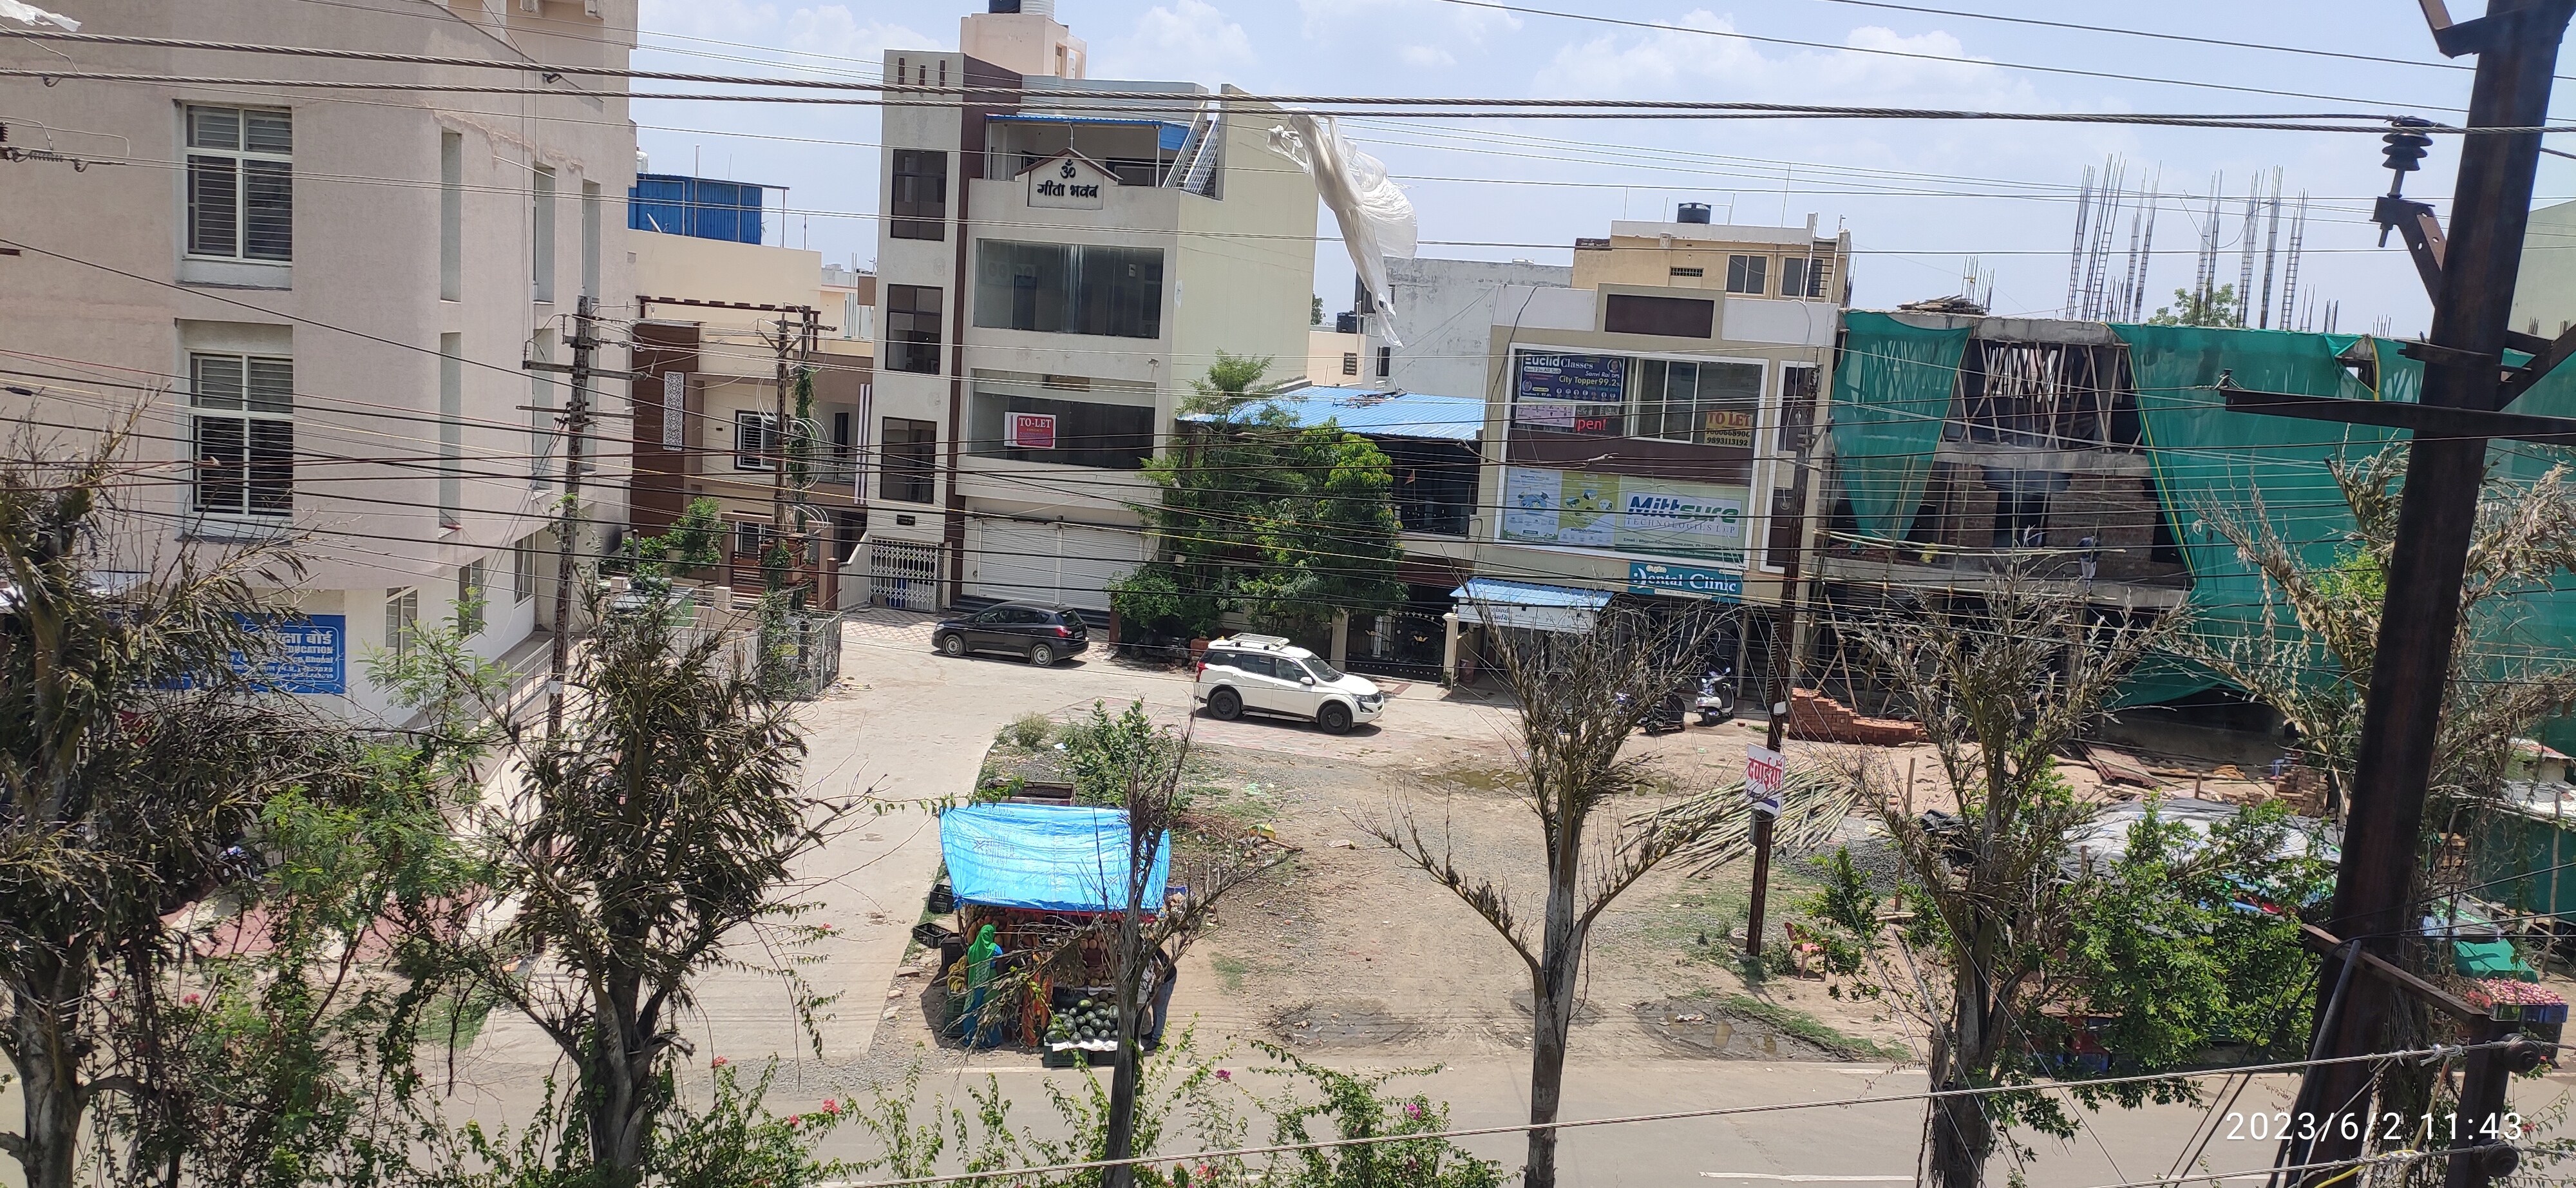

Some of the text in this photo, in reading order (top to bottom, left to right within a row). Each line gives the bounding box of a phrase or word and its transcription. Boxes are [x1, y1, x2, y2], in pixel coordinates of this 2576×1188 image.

[1037, 180, 1099, 198] गीता भवन
[1525, 354, 1594, 370] Euclid Classes
[1559, 375, 1573, 385] City
[1575, 376, 1598, 386] Topper
[1019, 417, 1052, 428] TO-LET
[1575, 419, 1608, 432] pen!
[1708, 412, 1750, 426] TO LET
[1707, 437, 1748, 446] 9893113192
[1628, 495, 1739, 524] Mittsure
[1626, 518, 1712, 531] TECHNOLOGIES
[1689, 573, 1736, 592] Clinic
[305, 630, 334, 644] बोर्ड
